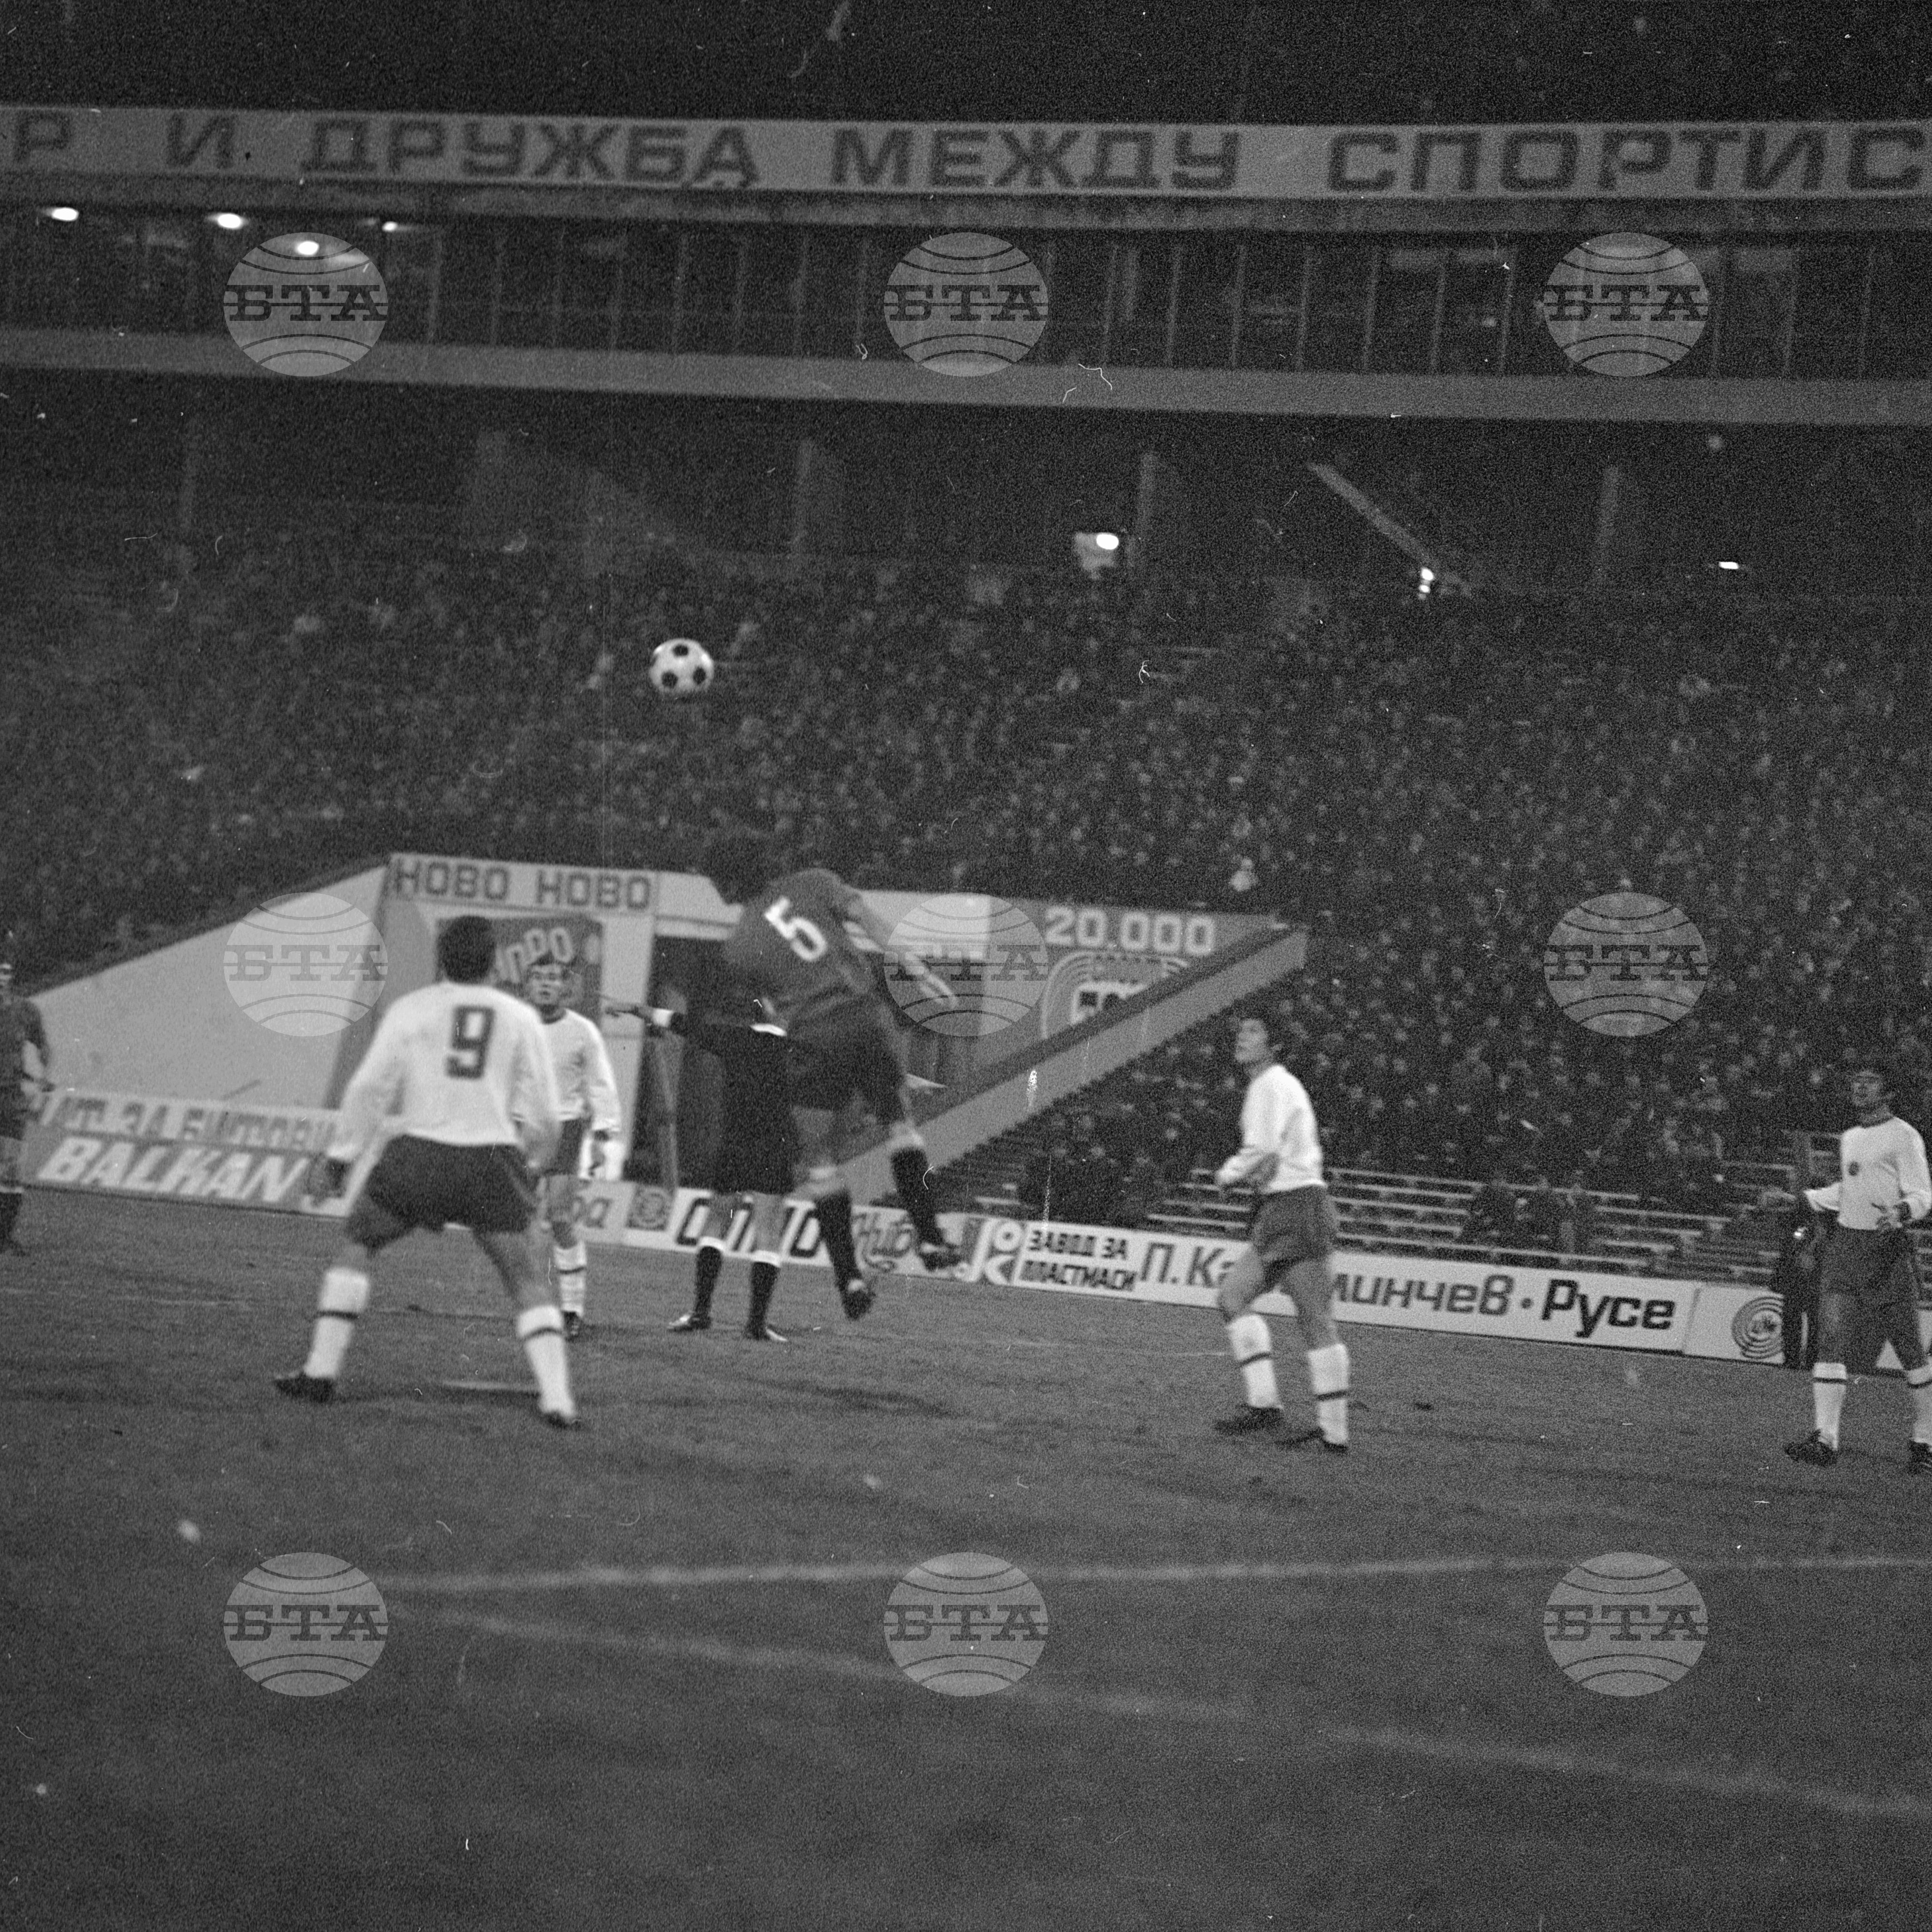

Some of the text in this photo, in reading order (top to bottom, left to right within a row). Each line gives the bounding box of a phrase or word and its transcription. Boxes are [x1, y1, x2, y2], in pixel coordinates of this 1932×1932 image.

[167, 112, 236, 169] И
[298, 118, 760, 189] ДРУЖБА
[829, 127, 1239, 191] МЕЖДУ
[1324, 129, 1927, 194] СПОРТИС
[392, 858, 650, 910] НОВО НОВО
[764, 895, 828, 962] 5
[1043, 905, 1215, 955] 20.000
[445, 1004, 497, 1079] 9
[38, 1137, 309, 1203] BALKAN
